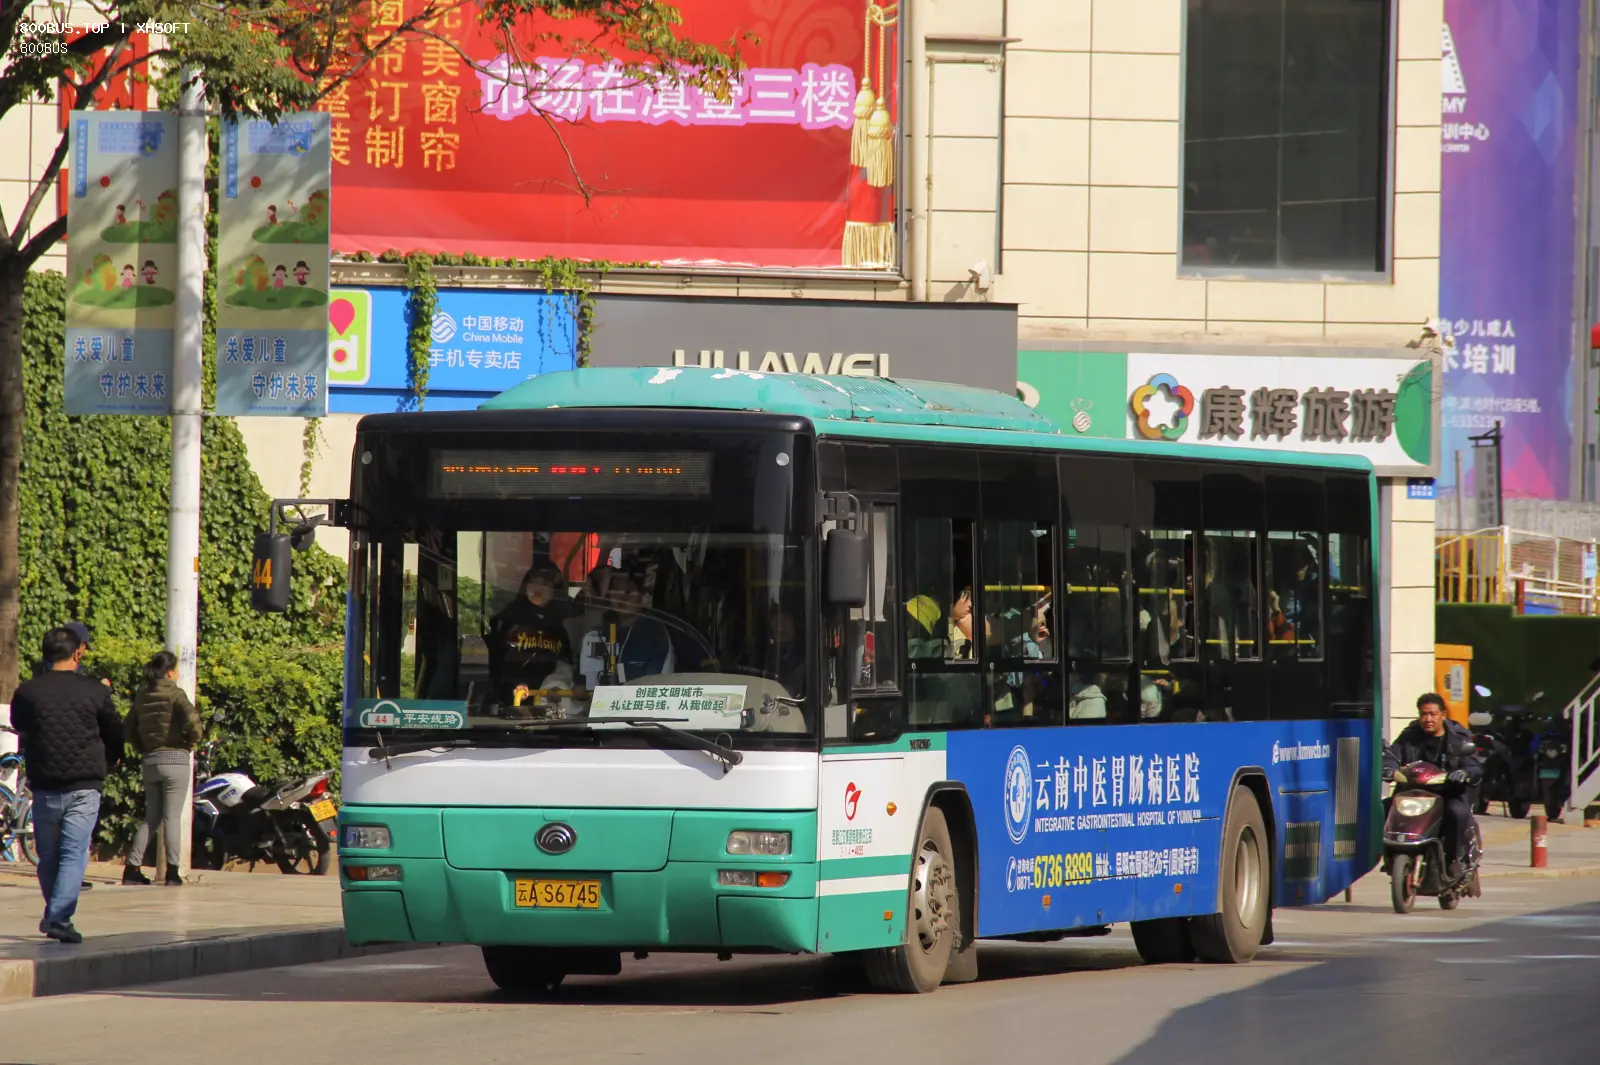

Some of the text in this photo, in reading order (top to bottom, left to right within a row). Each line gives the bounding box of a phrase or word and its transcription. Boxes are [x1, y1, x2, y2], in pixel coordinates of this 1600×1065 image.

[462, 315, 524, 332] 中国移动
[74, 335, 135, 362] 关爱儿童
[225, 336, 286, 363] 关爱儿童
[463, 332, 524, 344] China Mobile
[428, 348, 522, 370] 手机专卖店
[100, 371, 166, 399] 守护未来
[252, 372, 318, 400] 守护未来
[1202, 386, 1397, 442] 康辉旅游
[254, 558, 273, 589] 44
[635, 686, 704, 698] 创建文明城市
[375, 715, 387, 724] 44
[403, 713, 458, 725] 平安线路
[1035, 752, 1200, 811] 云南中医胃肠病医院
[1034, 815, 1075, 833] INTEGRATIVE
[1077, 813, 1135, 831] GASTROINTESTINAL
[1137, 811, 1165, 827] HOSPITAL
[1168, 811, 1175, 824] OF
[1034, 853, 1062, 889] 6736
[1064, 851, 1093, 885] 8899
